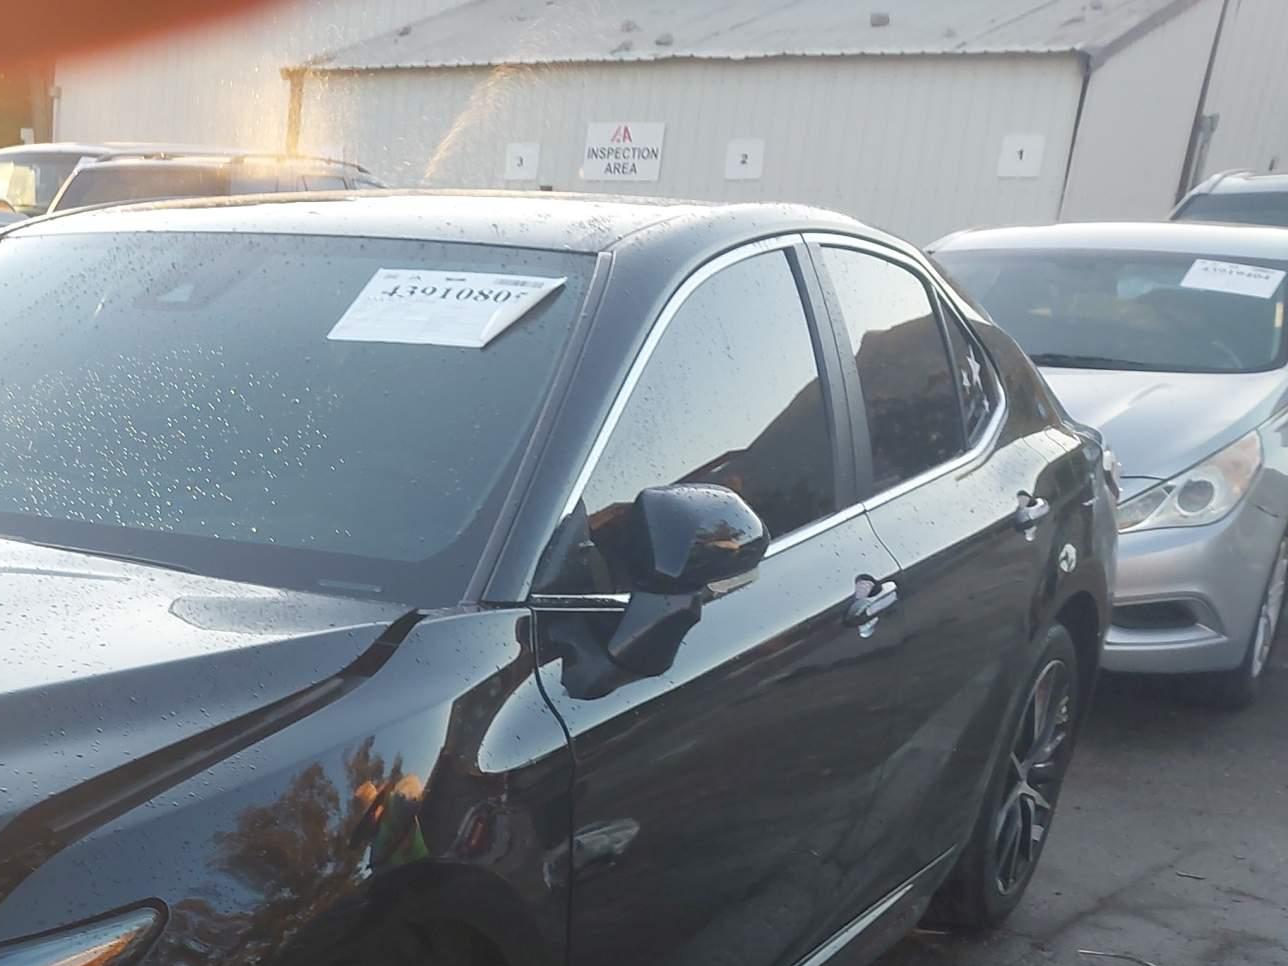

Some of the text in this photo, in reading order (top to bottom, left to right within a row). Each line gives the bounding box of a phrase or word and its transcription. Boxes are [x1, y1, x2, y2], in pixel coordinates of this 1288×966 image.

[586, 146, 660, 160] INSPECTION
[740, 152, 749, 166] 2
[1016, 148, 1024, 161] 1
[515, 155, 524, 168] 3
[603, 162, 638, 175] AREA
